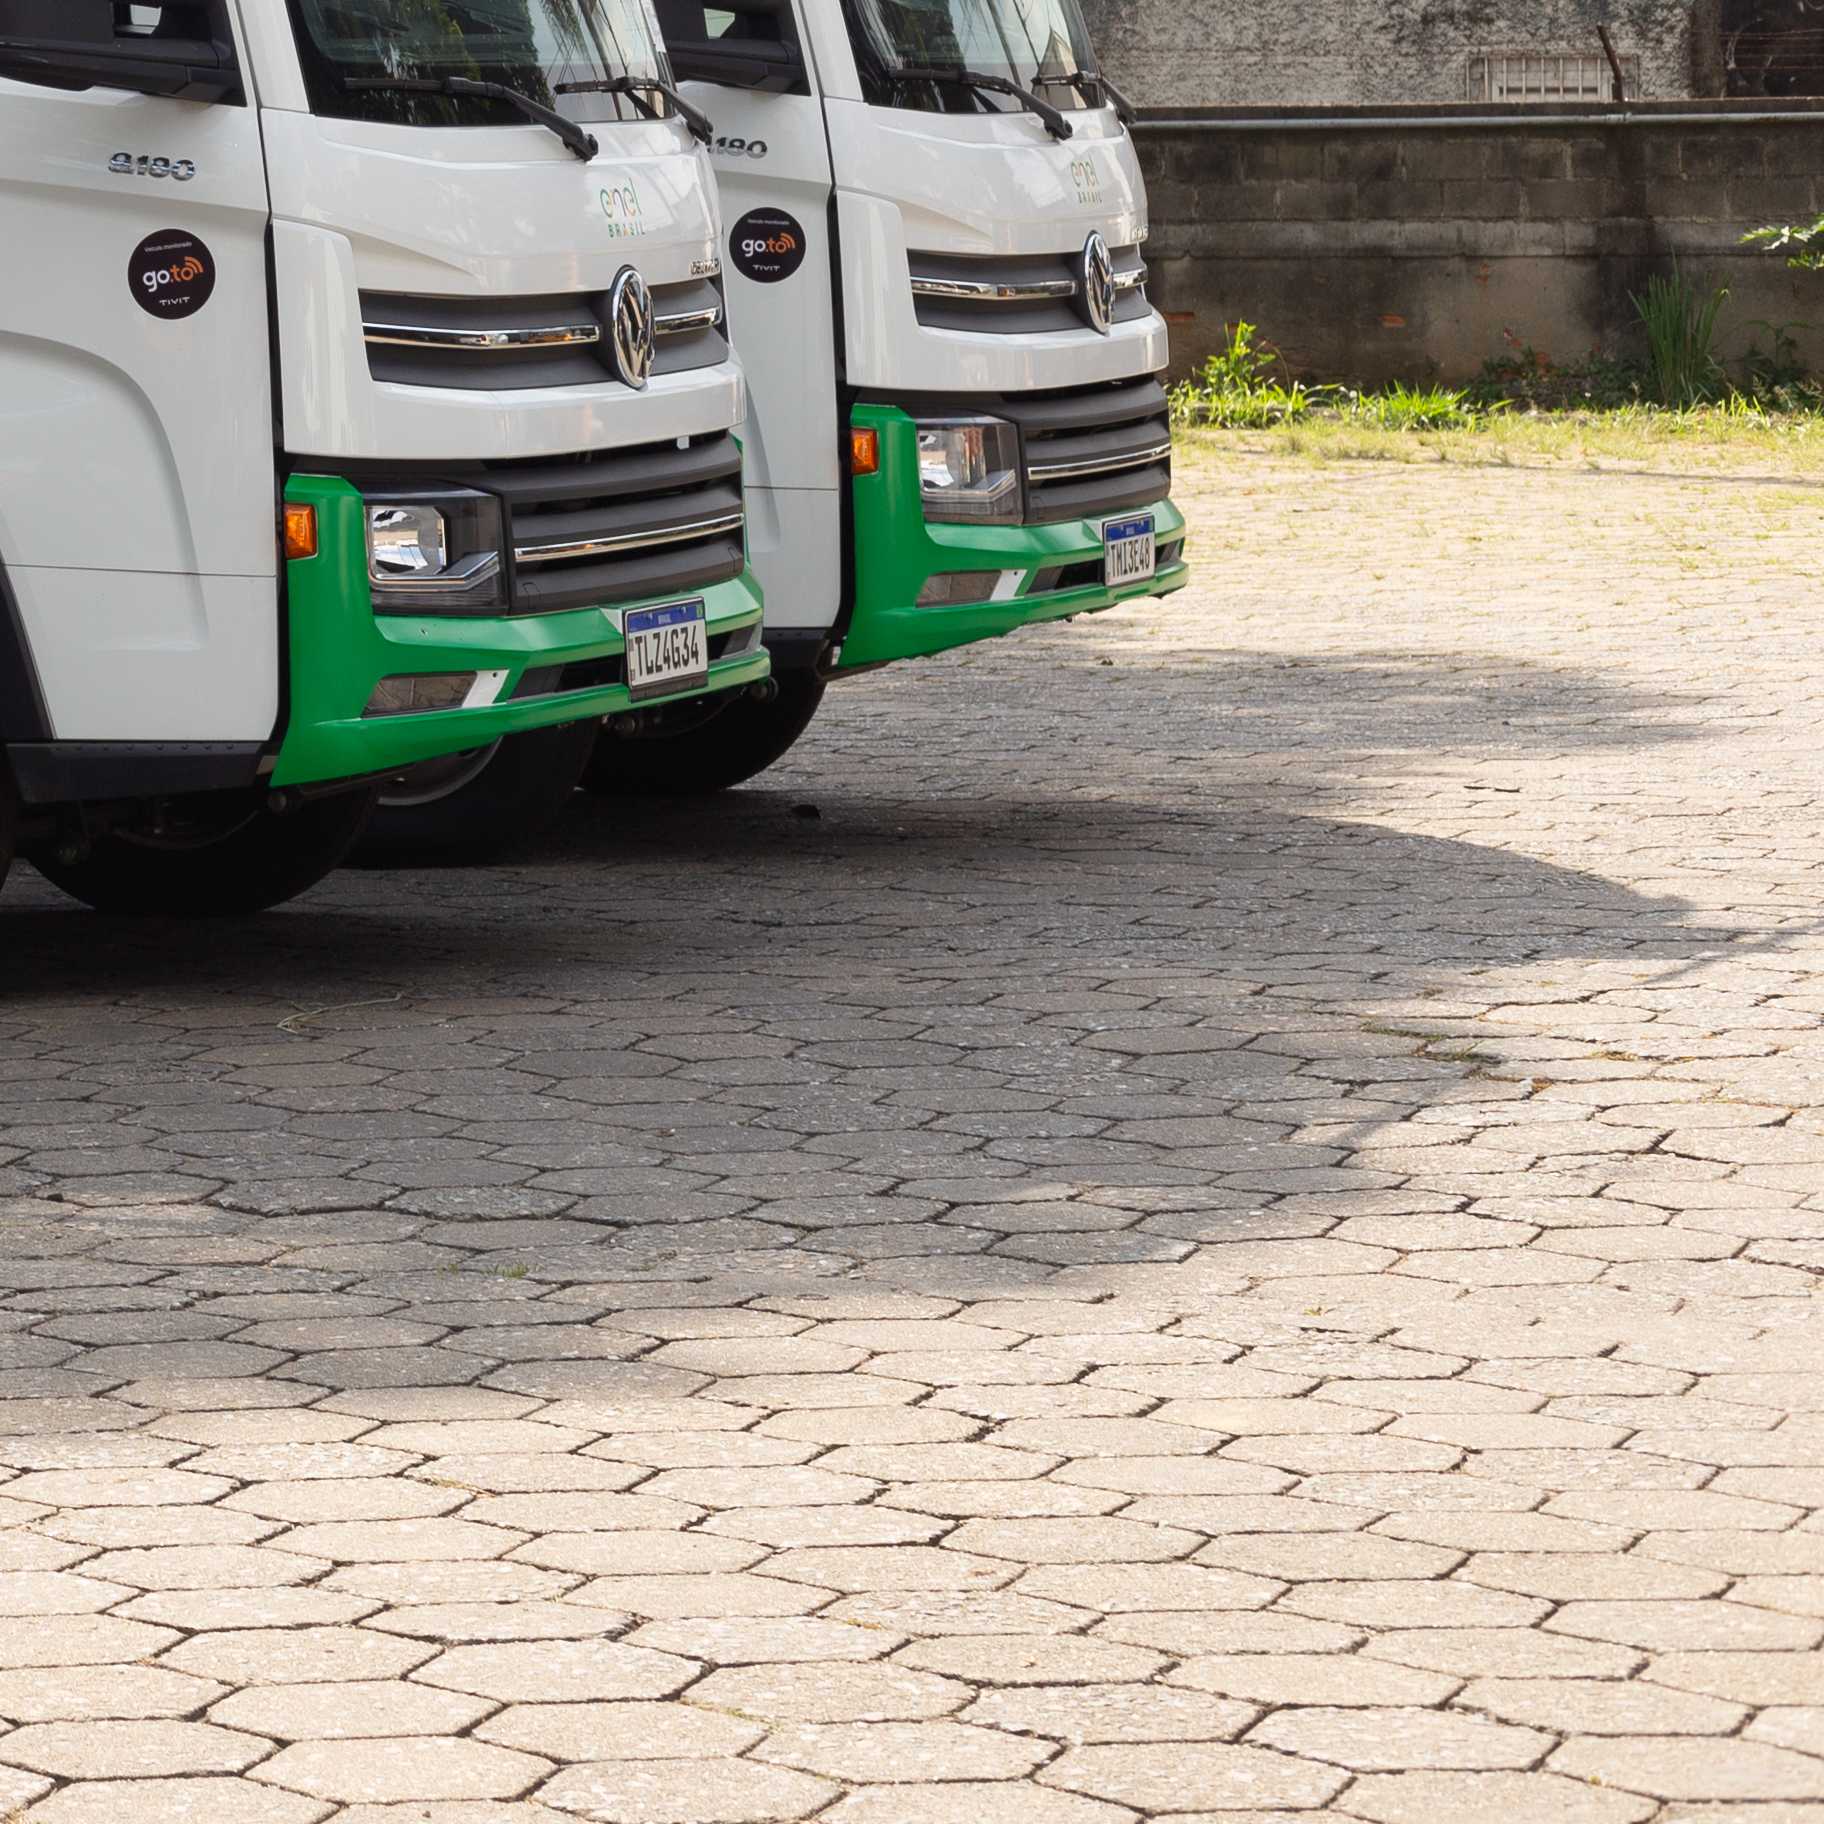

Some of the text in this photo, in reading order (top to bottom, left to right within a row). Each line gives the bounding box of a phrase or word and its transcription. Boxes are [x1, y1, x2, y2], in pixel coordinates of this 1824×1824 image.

[600, 177, 642, 218] enel
[608, 222, 645, 238] BRASIL
[159, 296, 191, 306] TIVIT
[635, 625, 699, 677] TLZ4G34
